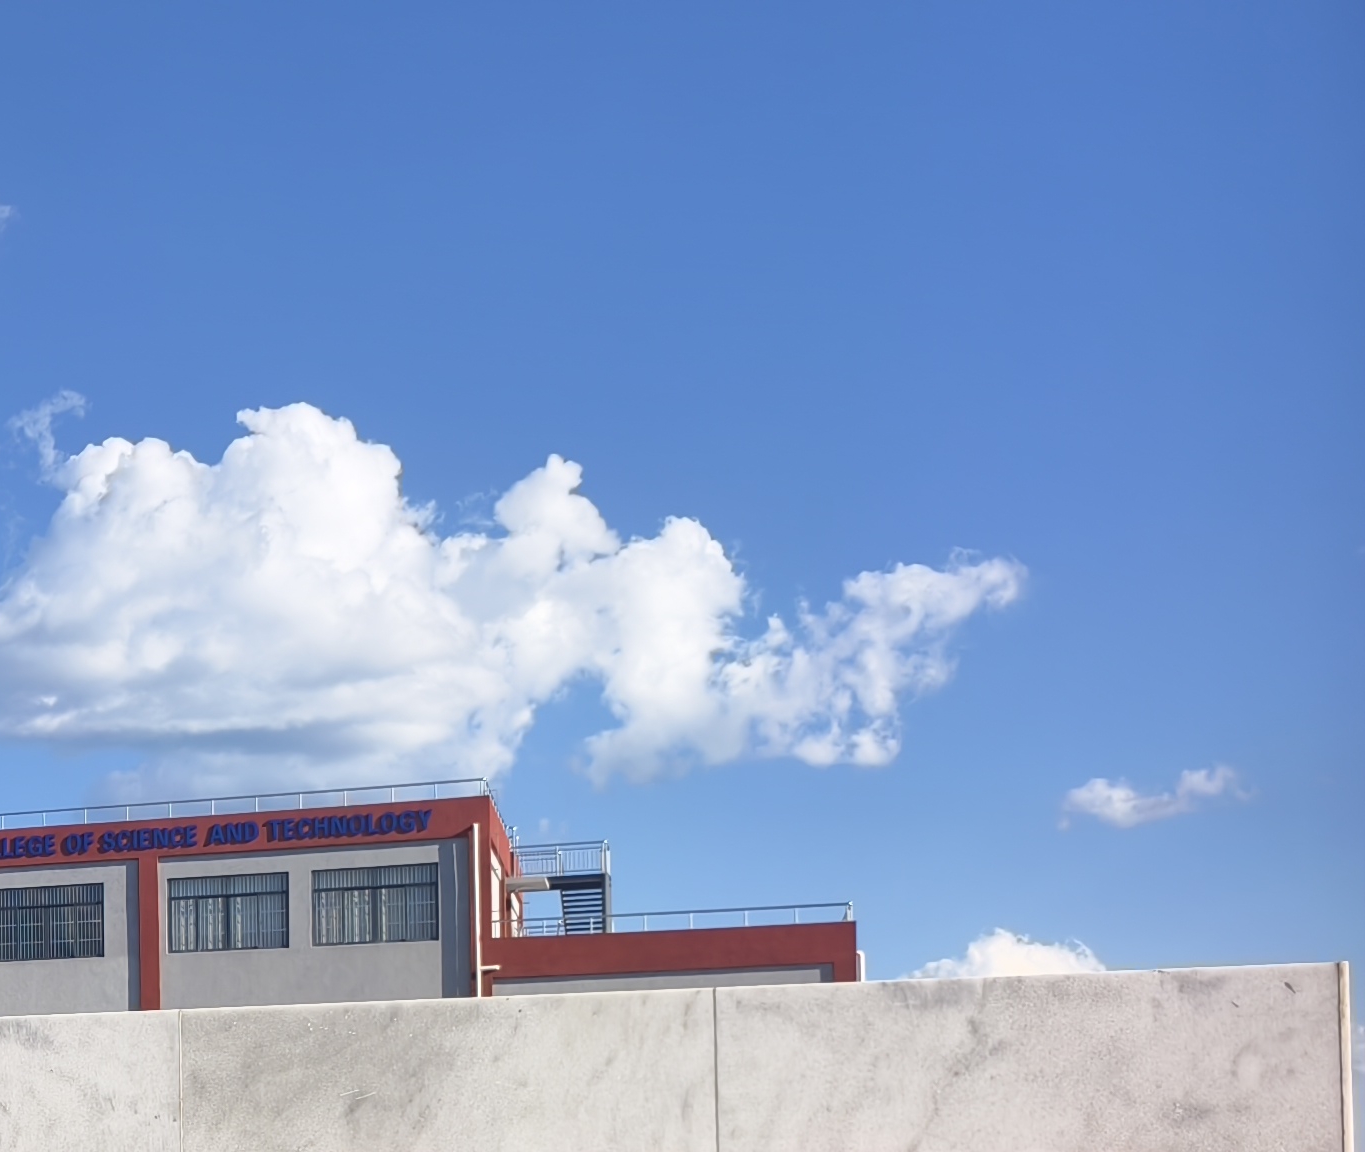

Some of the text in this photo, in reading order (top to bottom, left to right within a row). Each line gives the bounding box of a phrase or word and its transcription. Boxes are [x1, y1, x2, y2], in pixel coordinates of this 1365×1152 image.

[62, 831, 94, 856] OF
[99, 825, 198, 852] SCIENCE
[205, 820, 259, 847] AND
[263, 809, 432, 842] TECHNOLOGY
